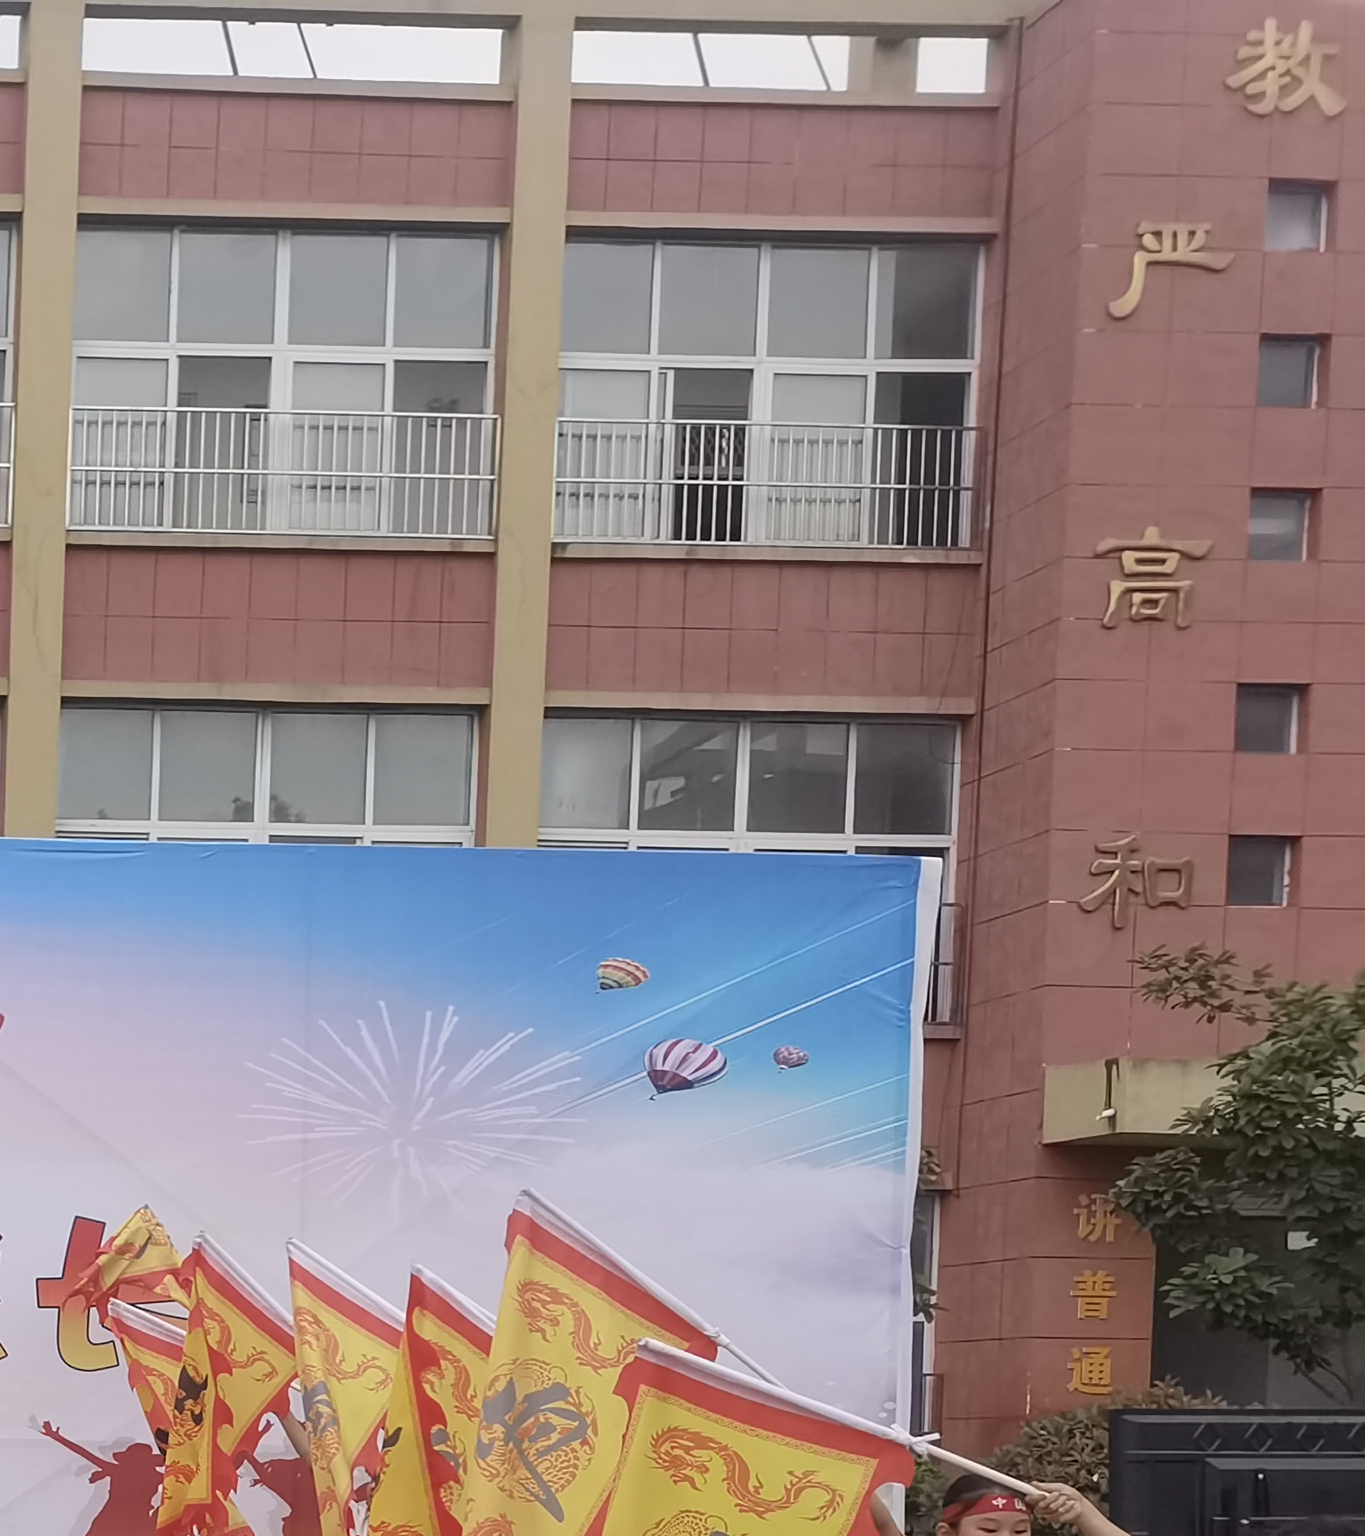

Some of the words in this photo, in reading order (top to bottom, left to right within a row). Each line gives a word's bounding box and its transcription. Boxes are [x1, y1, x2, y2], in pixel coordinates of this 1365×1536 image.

[1224, 17, 1349, 120] 教
[1107, 220, 1235, 321] 严
[1093, 525, 1216, 631] 高
[1078, 830, 1196, 930] 和
